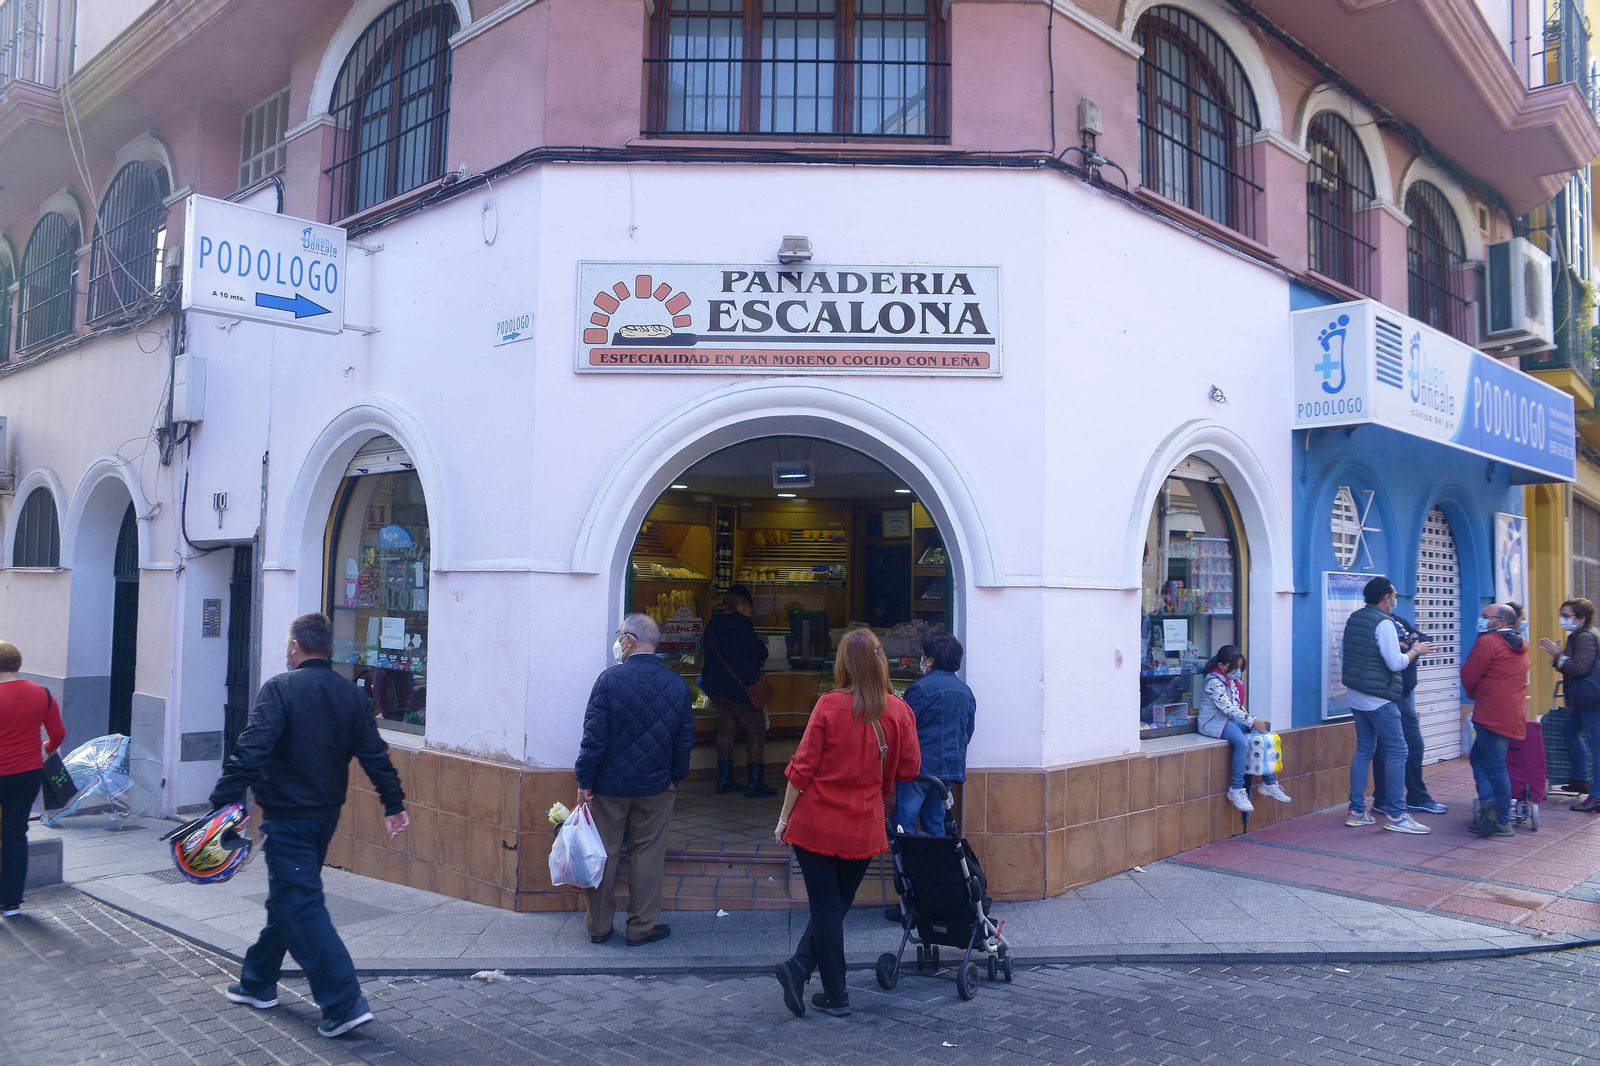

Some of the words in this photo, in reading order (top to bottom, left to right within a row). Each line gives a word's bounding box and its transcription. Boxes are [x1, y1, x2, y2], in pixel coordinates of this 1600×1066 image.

[199, 236, 338, 294] PODOLOGO
[721, 270, 977, 295] PANADERIA
[220, 291, 229, 299] 10
[230, 294, 246, 302] mts.
[497, 315, 529, 335] PODOLOGO
[707, 300, 991, 335] ESCALONA
[600, 353, 709, 365] ESPECIALIDAD
[715, 354, 735, 365] EN
[739, 354, 768, 366] PAN
[772, 354, 836, 366] MORENO
[841, 355, 901, 367] COCIDO
[905, 355, 938, 367] CON
[941, 353, 980, 367] LEÑA
[1421, 351, 1445, 391] Juan
[1298, 397, 1362, 418] PODOLOGO
[1473, 376, 1546, 451] PODOLOGO
[1434, 416, 1443, 426] del
[214, 492, 227, 509] 10
